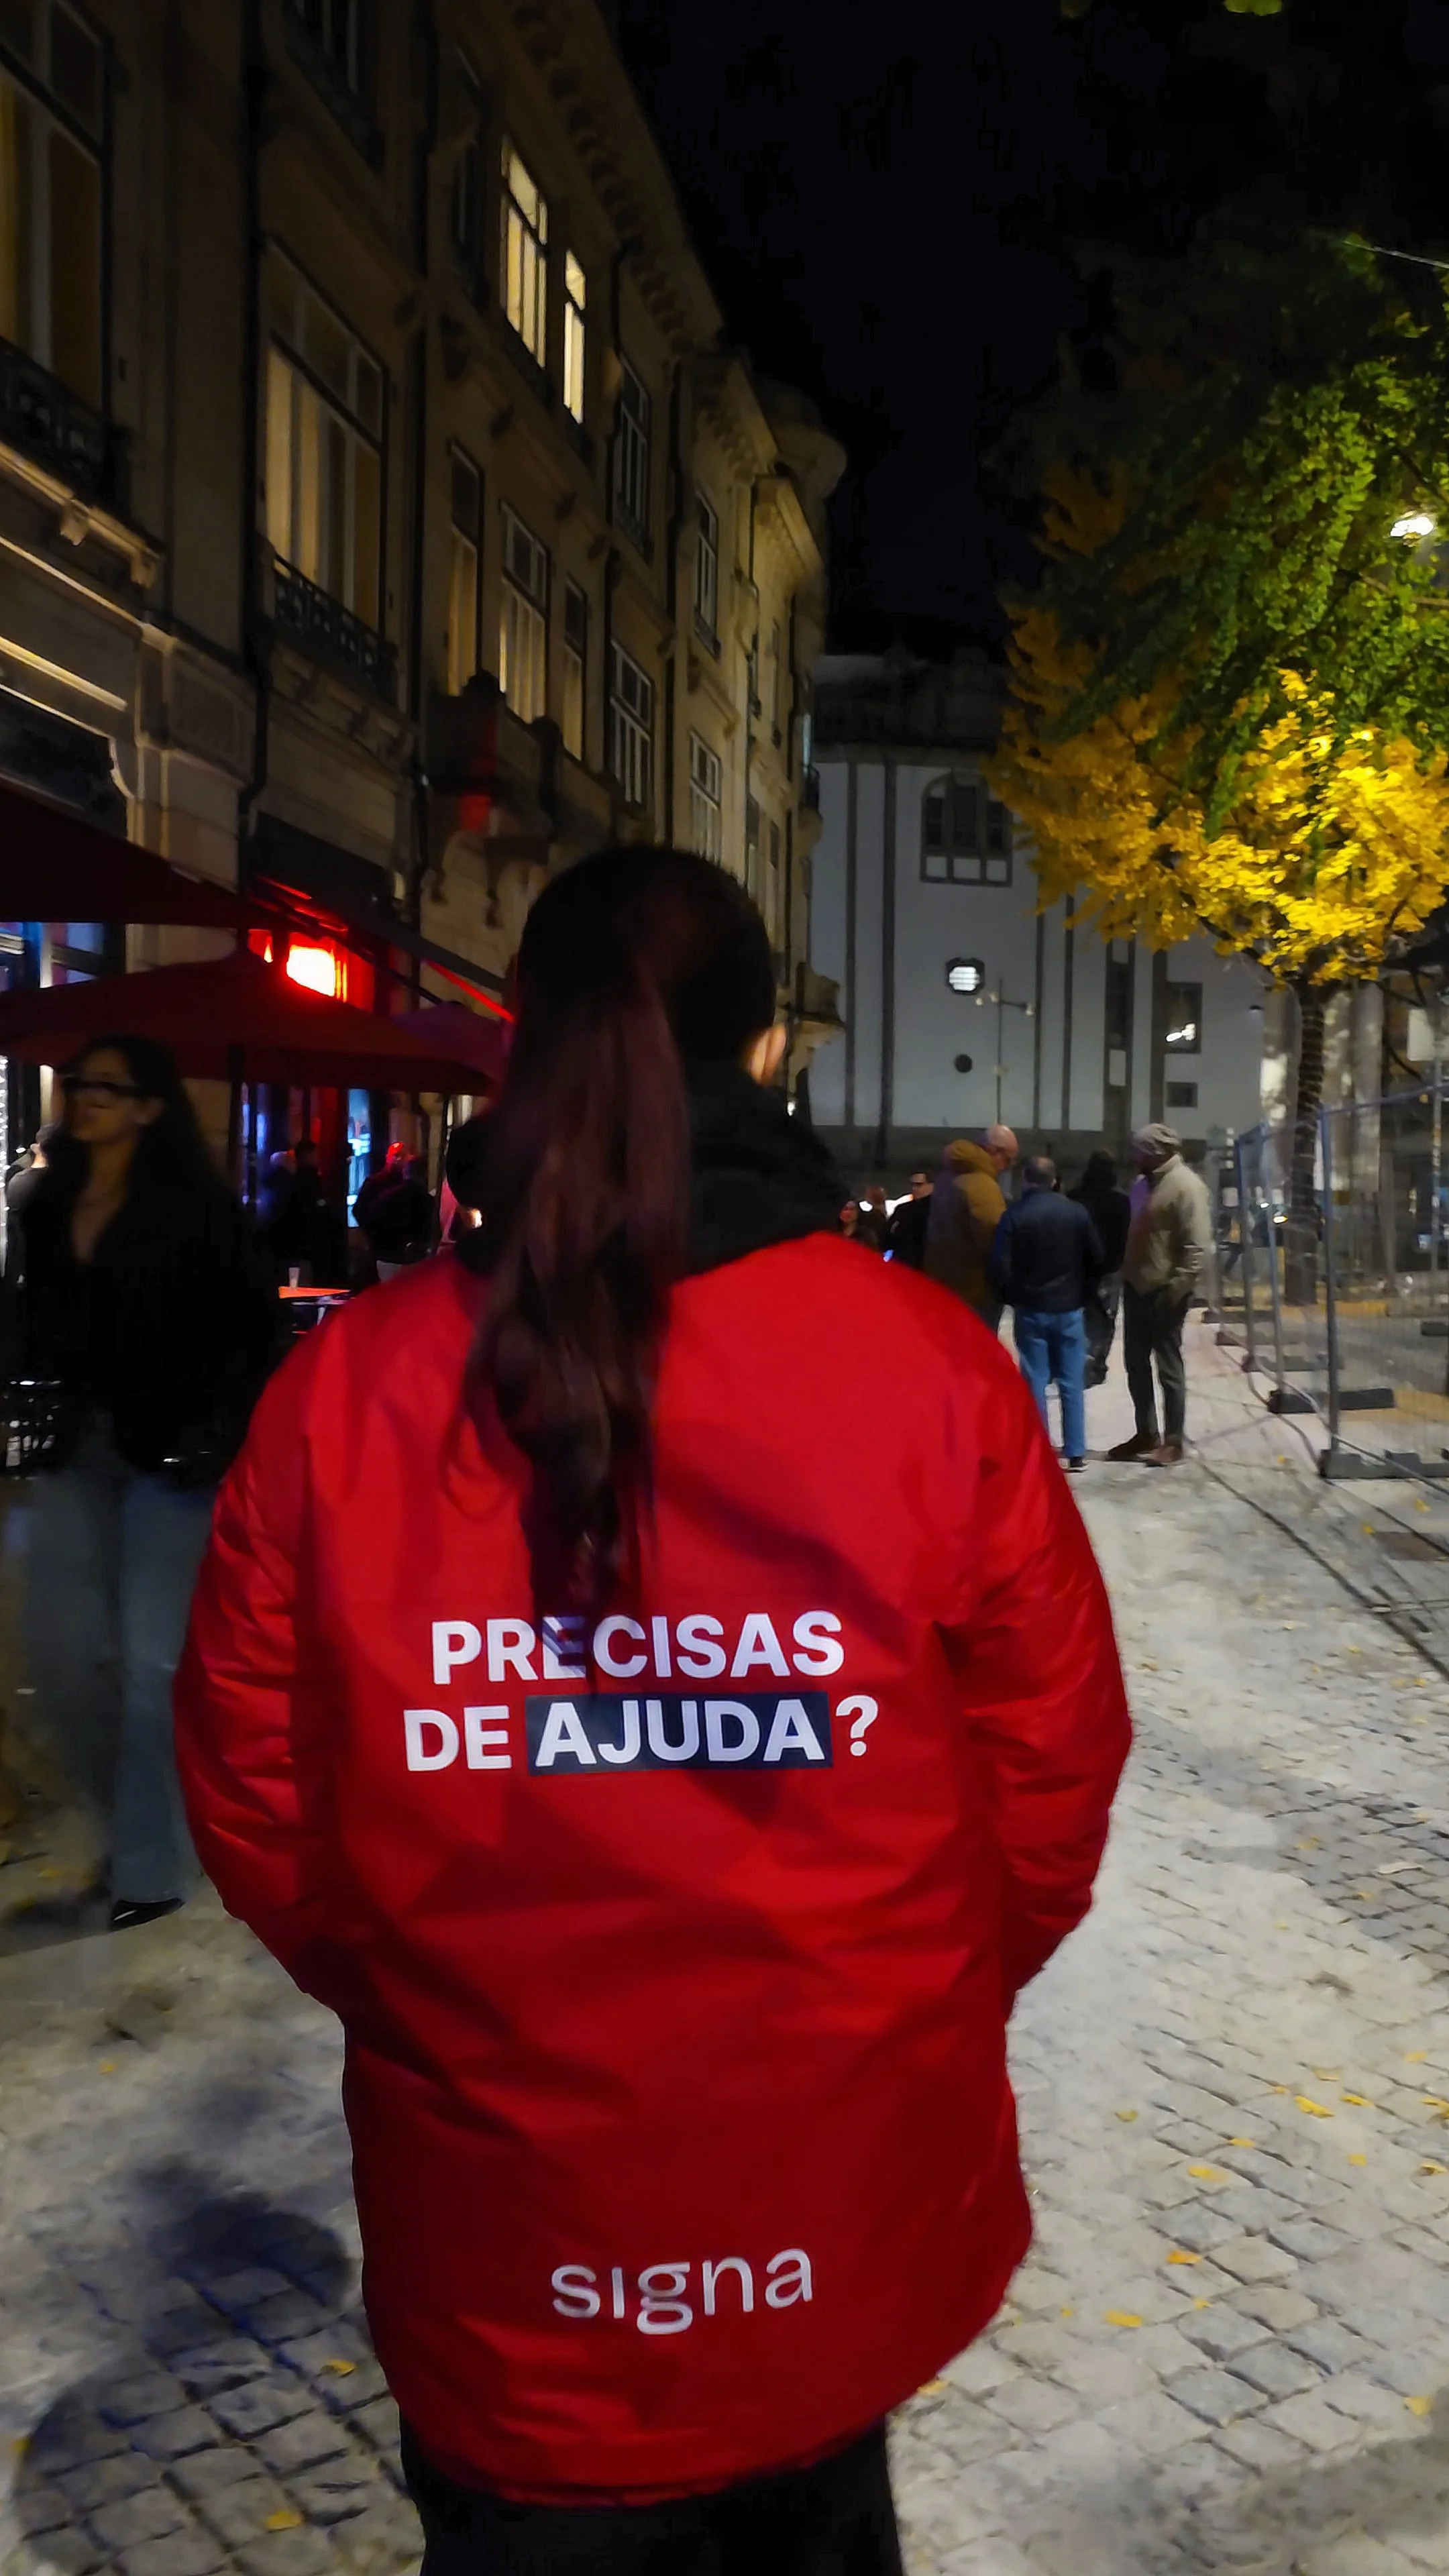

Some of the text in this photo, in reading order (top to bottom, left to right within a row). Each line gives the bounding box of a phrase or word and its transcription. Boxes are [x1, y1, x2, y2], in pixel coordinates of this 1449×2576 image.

[431, 1610, 845, 1685] PRECISAS
[402, 1694, 879, 1772] DE AJUDA?
[551, 2248, 812, 2334] signa
